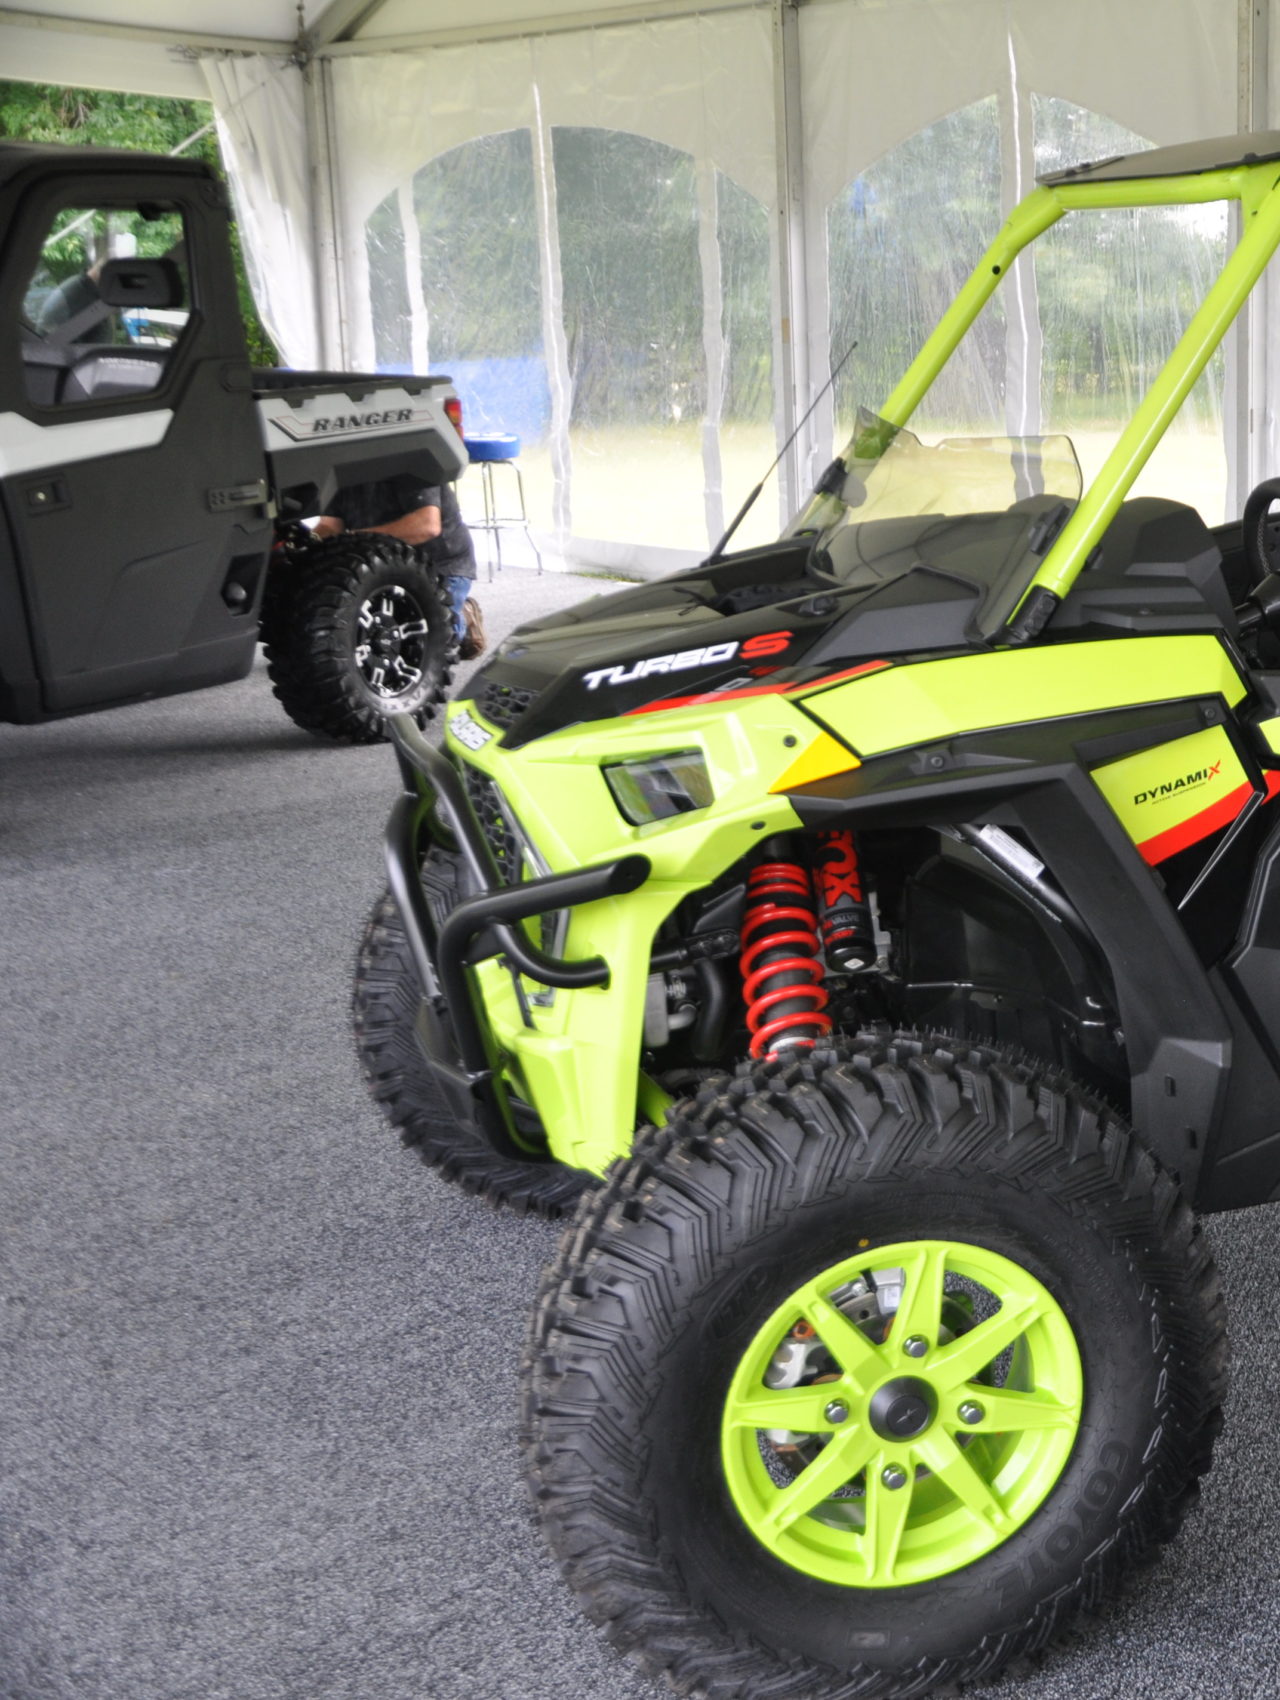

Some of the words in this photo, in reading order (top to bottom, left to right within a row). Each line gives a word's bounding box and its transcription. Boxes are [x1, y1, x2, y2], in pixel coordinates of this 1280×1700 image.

[313, 408, 412, 432] RANGER
[582, 641, 740, 690] TURBO
[739, 630, 794, 659] S
[1134, 760, 1221, 805] DYNAMIX
[992, 1439, 1128, 1597] COYOTE
